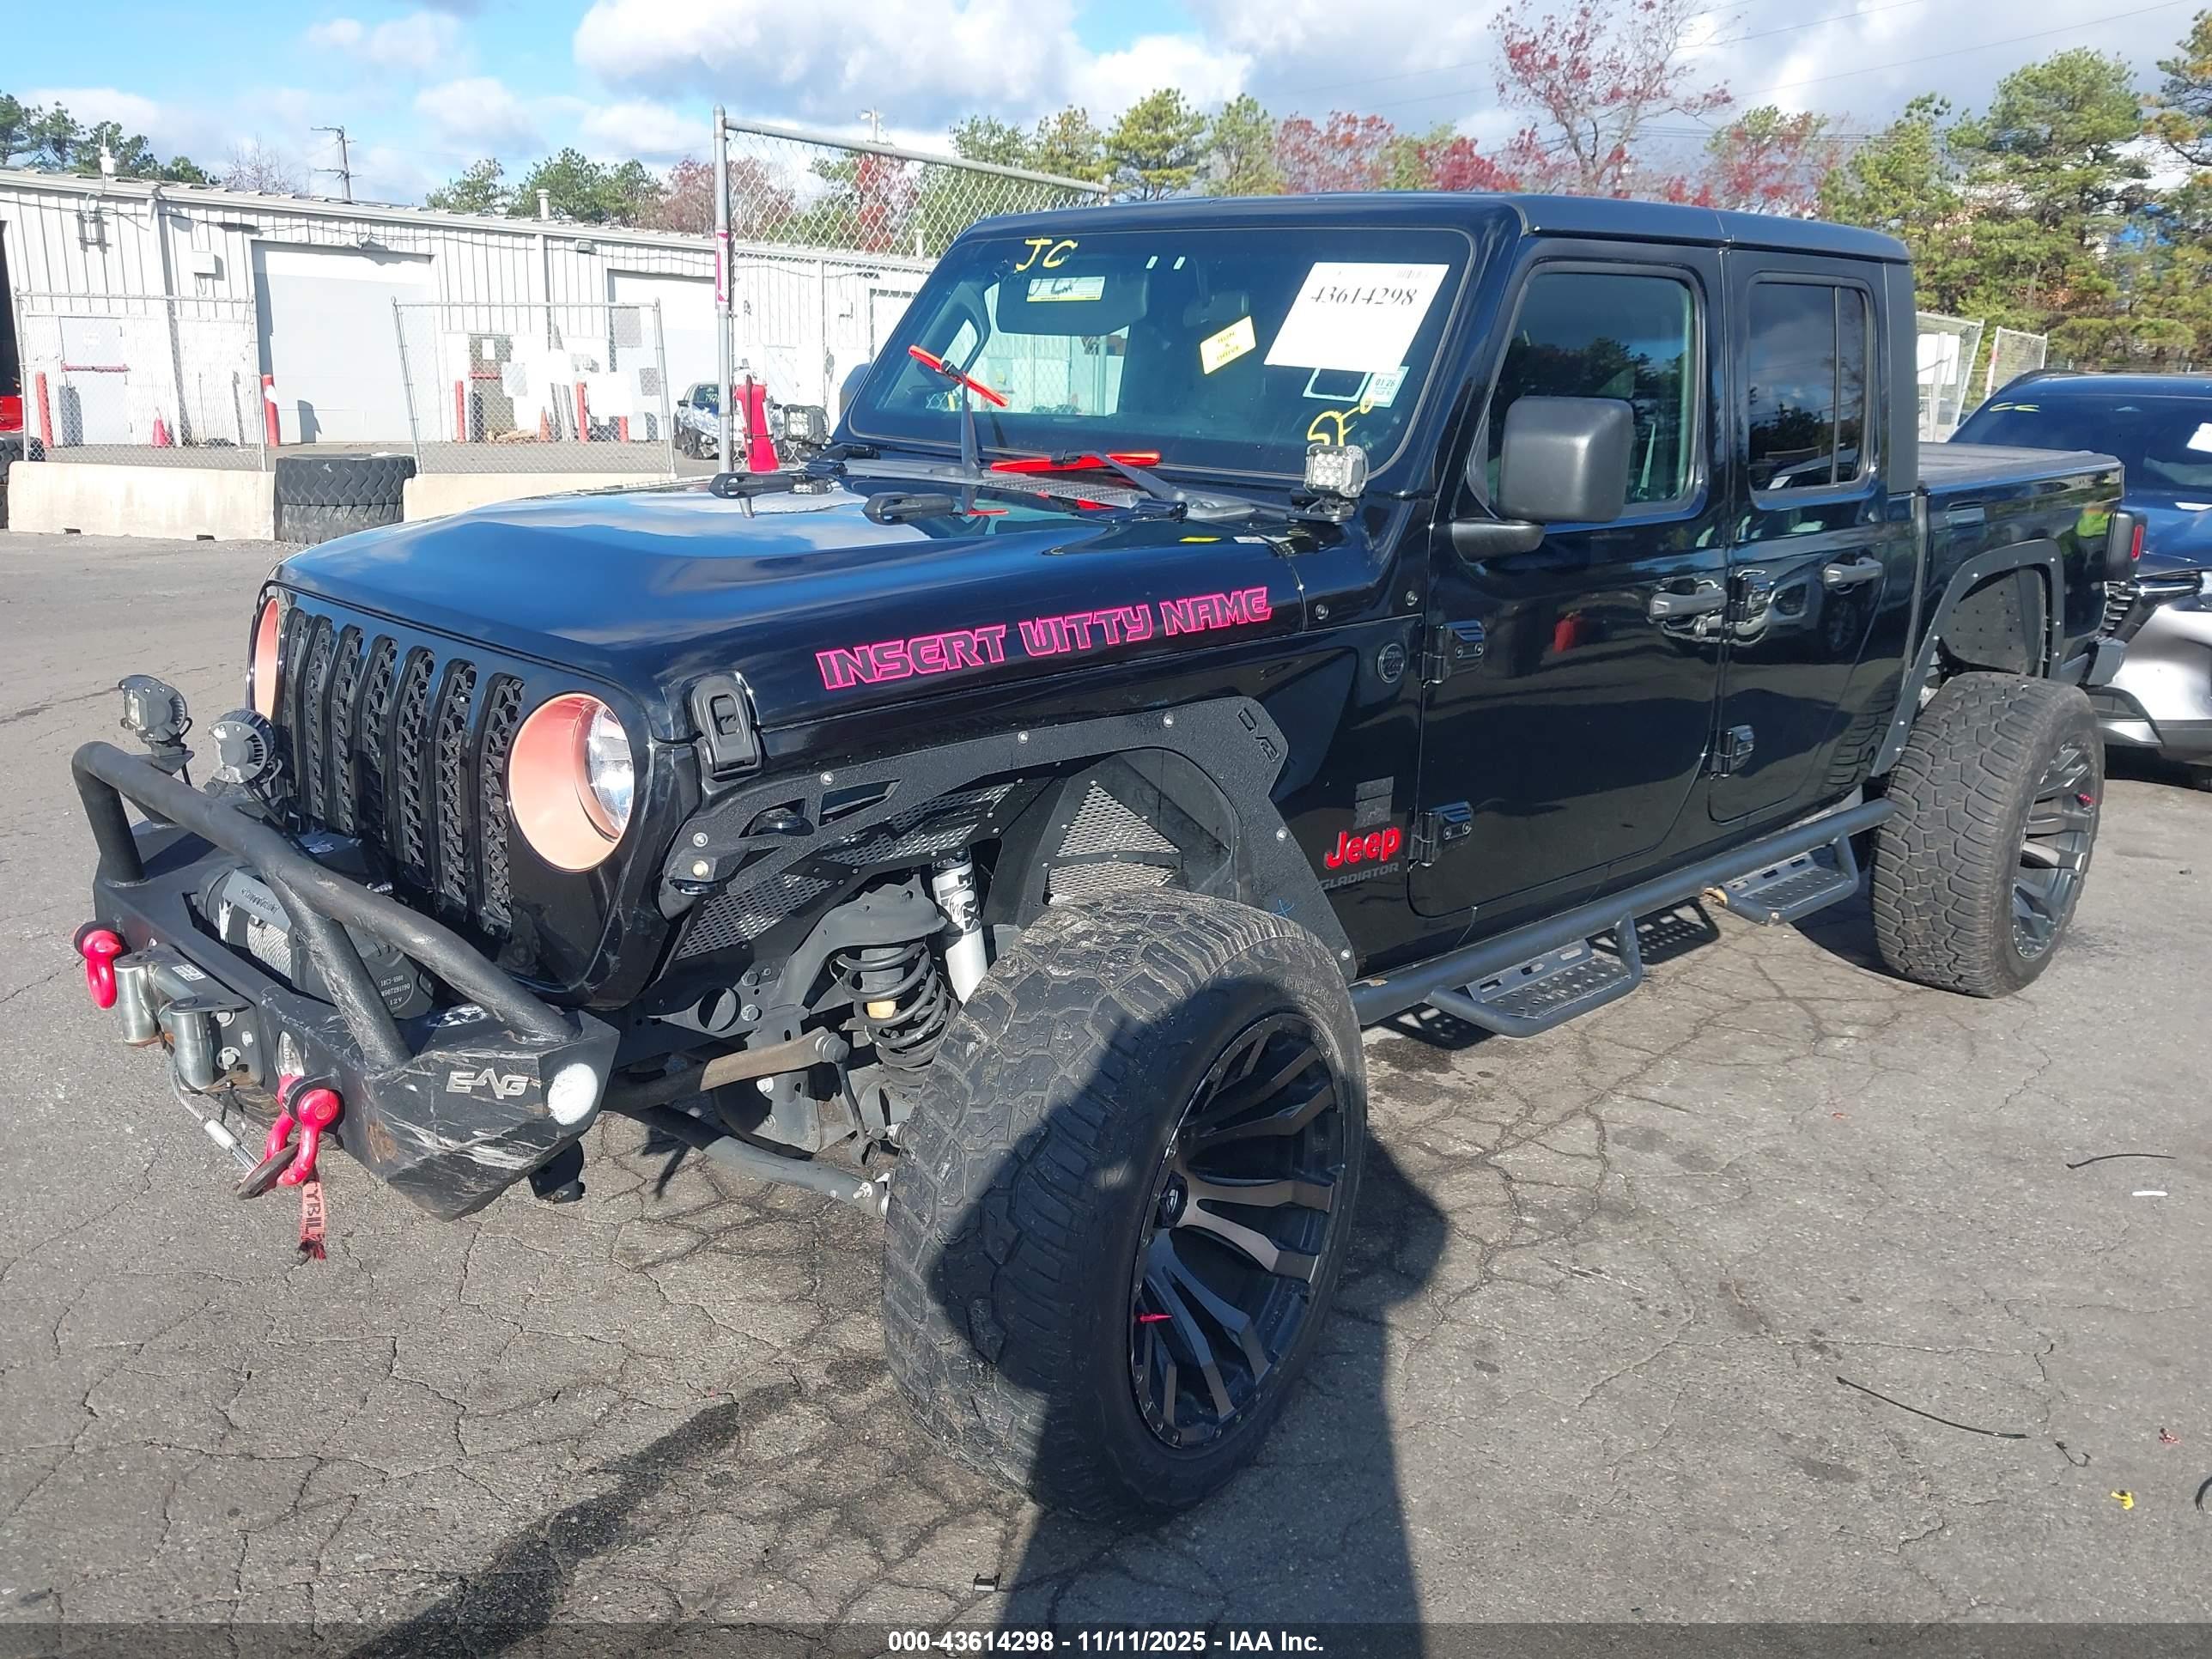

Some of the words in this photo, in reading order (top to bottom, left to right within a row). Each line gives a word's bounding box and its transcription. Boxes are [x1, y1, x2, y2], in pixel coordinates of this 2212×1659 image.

[1310, 286, 1418, 306] 43614298
[815, 624, 1007, 690] INSERT
[1018, 604, 1154, 657] WITTY
[1158, 586, 1273, 638] NAME
[1324, 826, 1402, 871] Jeep
[1319, 861, 1401, 890] GLADIATOR
[446, 1067, 529, 1100] EAG
